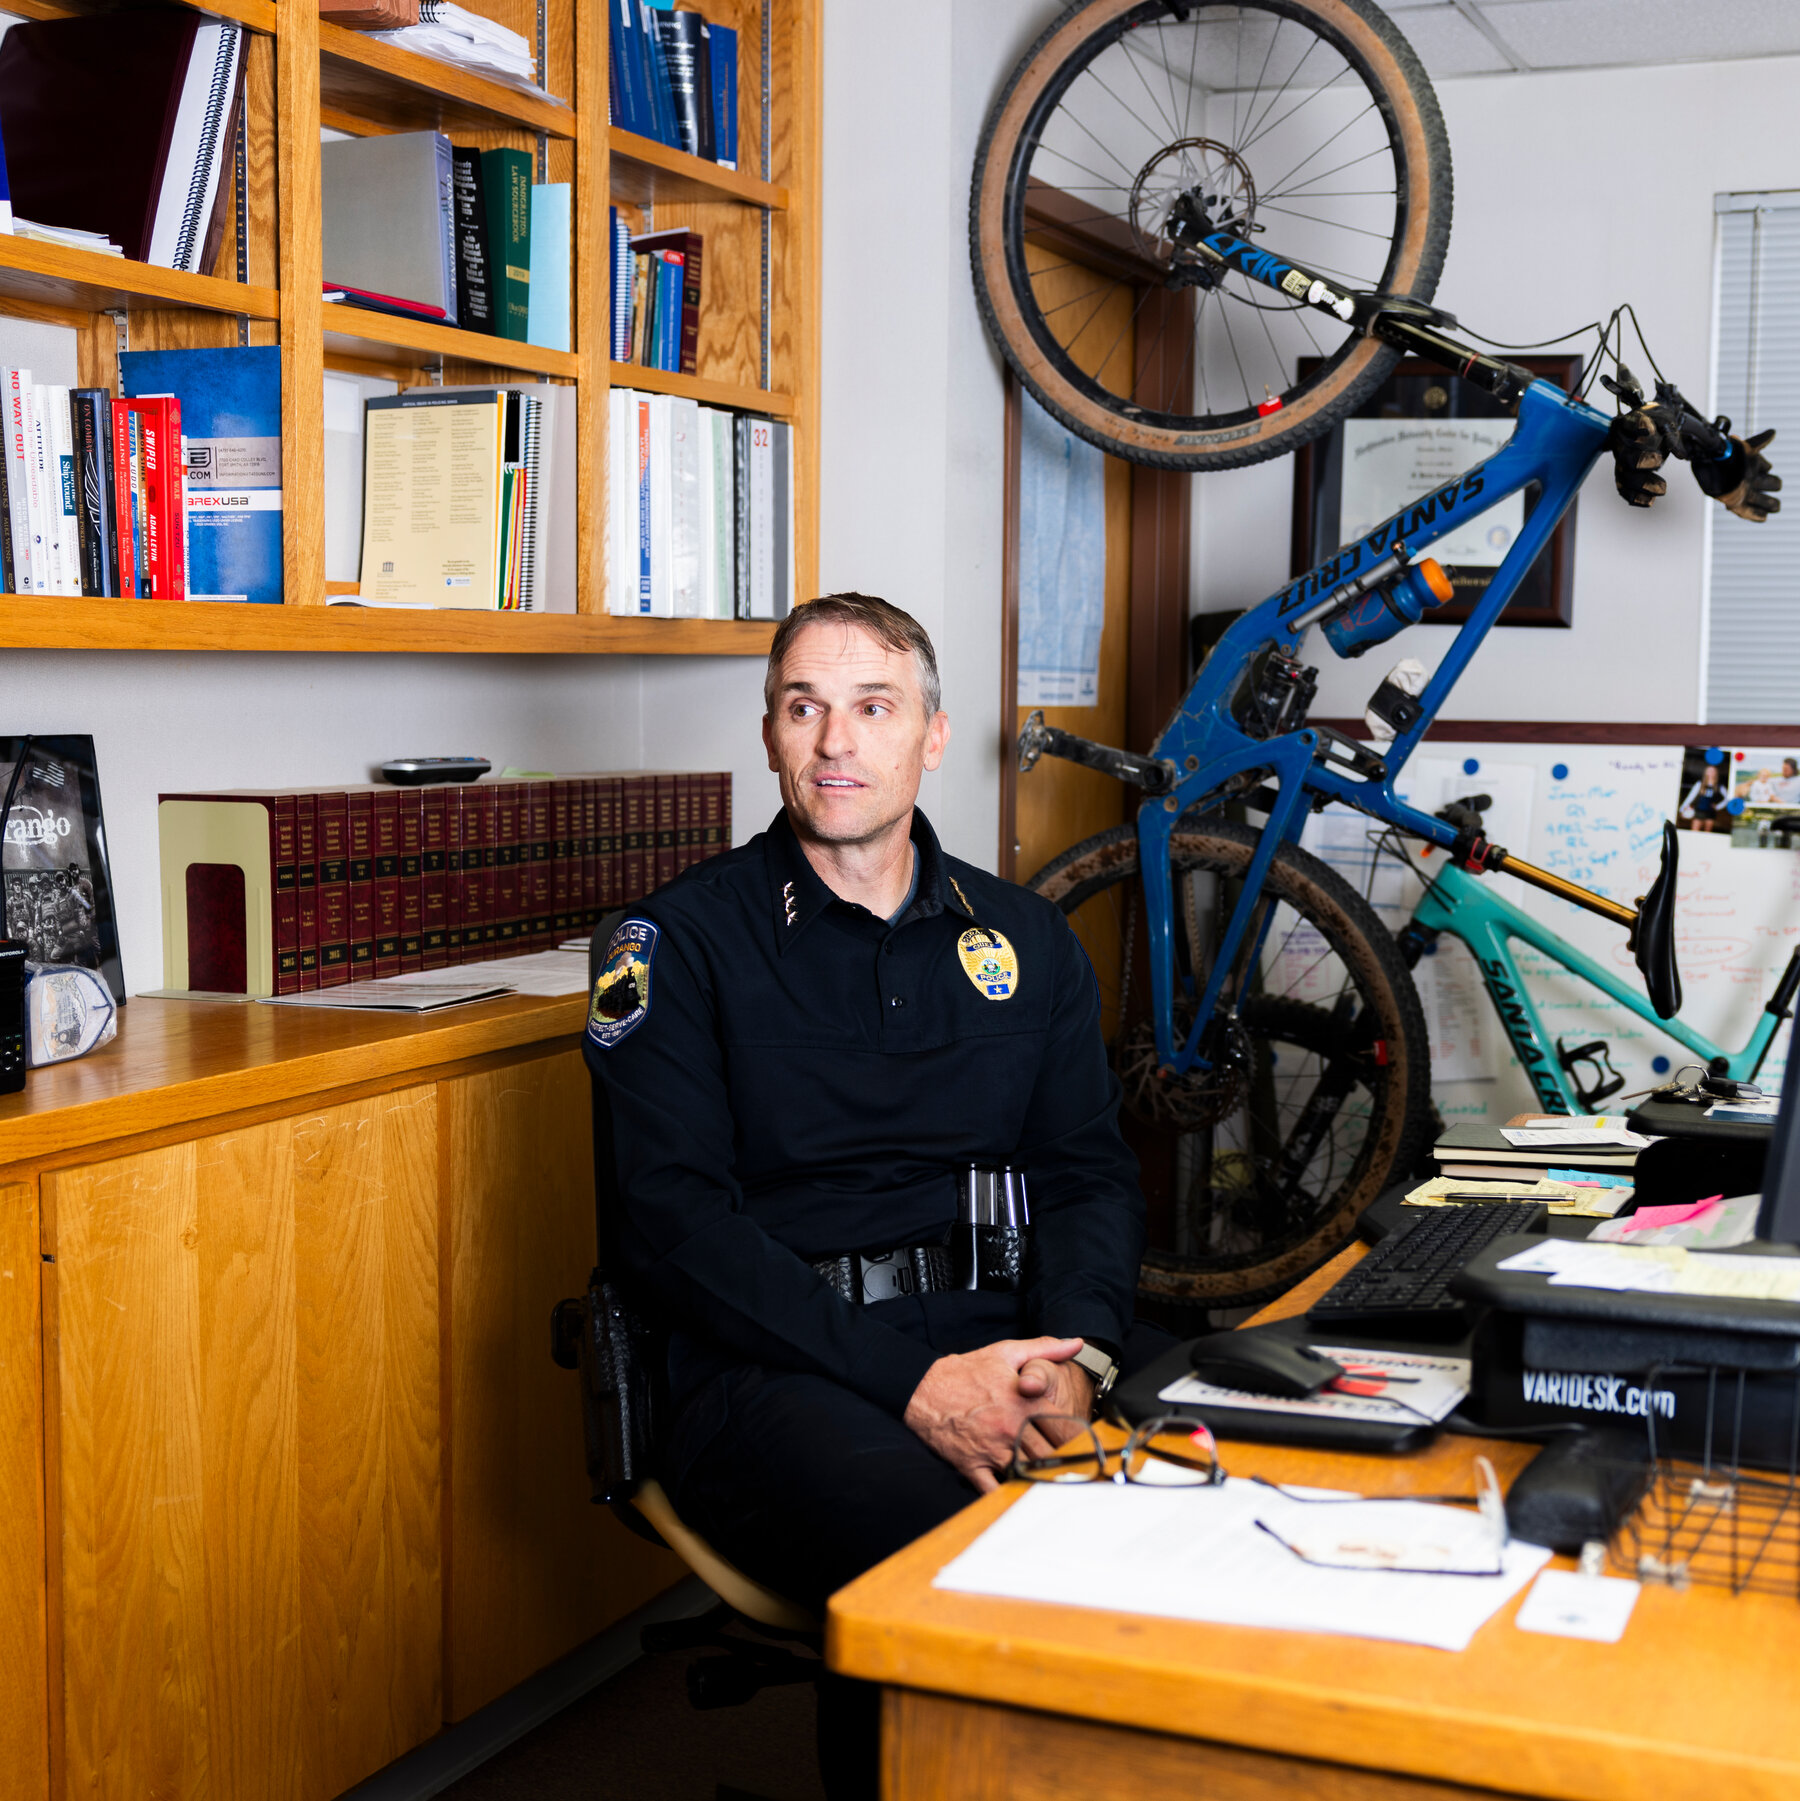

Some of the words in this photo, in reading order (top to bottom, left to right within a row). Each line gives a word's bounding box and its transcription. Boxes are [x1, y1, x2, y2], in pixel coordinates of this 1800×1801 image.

[511, 186, 519, 243] SOURCEBOOK
[519, 175, 527, 237] IMMIGRATION
[1203, 233, 1292, 289] LYRIK
[11, 371, 20, 390] NO
[13, 397, 23, 427] WAY
[26, 392, 34, 433] Leading
[84, 404, 91, 417] ON
[118, 413, 123, 425] ON
[15, 434, 25, 461] OUT
[36, 420, 44, 472] ATTITUDE
[84, 419, 93, 452] COMBAT
[145, 429, 156, 470] SWIPED
[754, 429, 768, 447] 32
[62, 461, 71, 478] Ship
[173, 467, 179, 477] OF
[63, 478, 72, 510] Around!
[1367, 465, 1487, 557] SANTA
[1276, 544, 1362, 619] CRUZ
[4, 808, 71, 845] rango
[981, 971, 1011, 982] POLICE
[1482, 958, 1545, 1066] SANTA
[1523, 1370, 1676, 1419] VARIDESK.com
